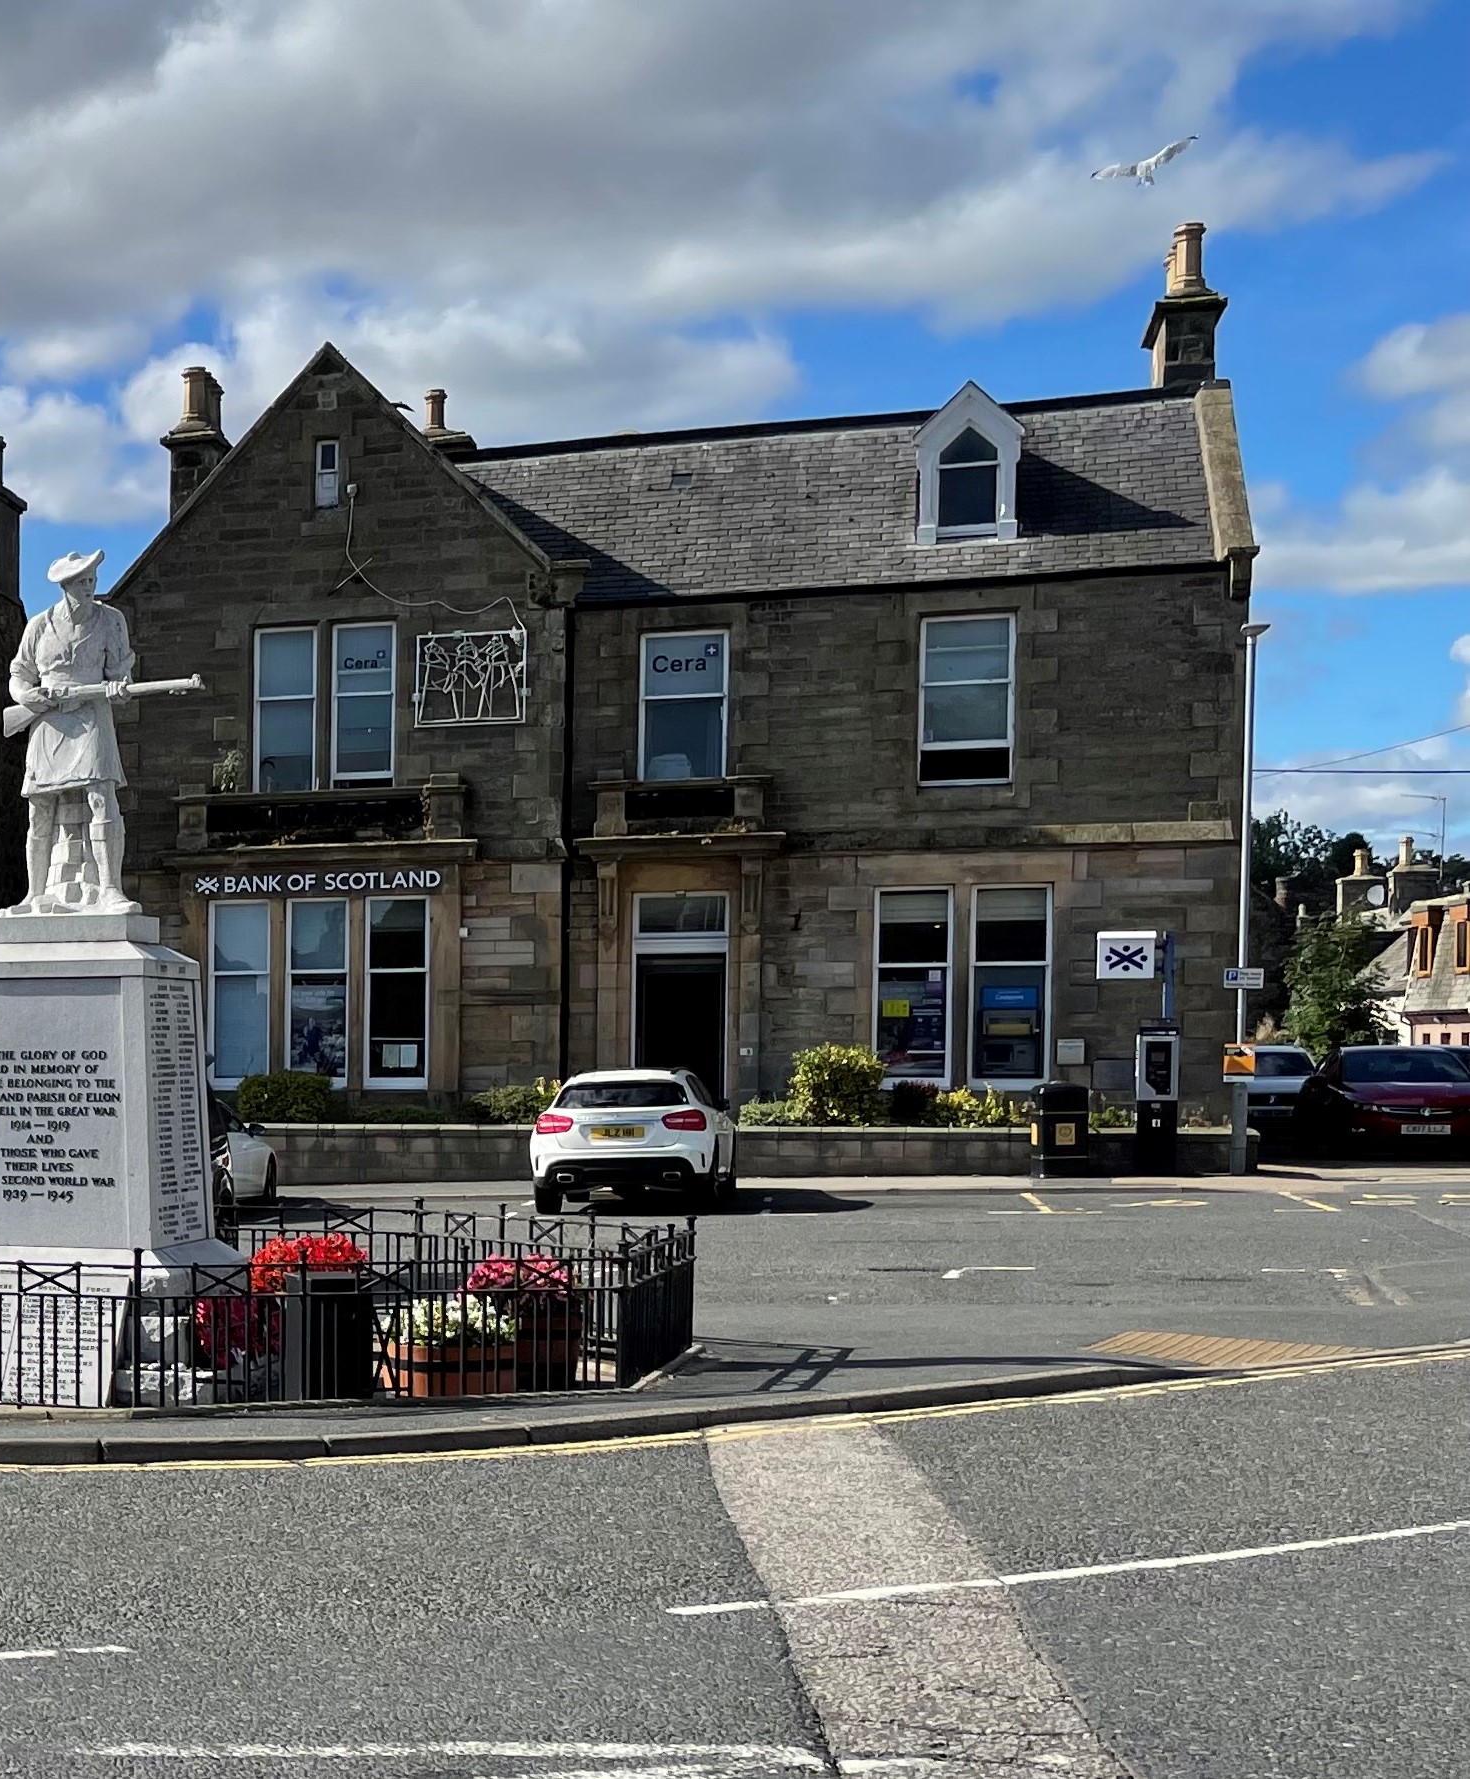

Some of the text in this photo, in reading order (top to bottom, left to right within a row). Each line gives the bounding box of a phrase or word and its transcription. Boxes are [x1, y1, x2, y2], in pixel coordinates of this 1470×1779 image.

[344, 657, 378, 669] Cera
[652, 655, 706, 673] Cera
[223, 870, 441, 893] BANK OF SCOTLAND
[20, 1050, 58, 1060] GLORY
[62, 1050, 76, 1060] OF
[81, 1050, 107, 1060] GOD
[13, 1064, 26, 1074] IN
[31, 1064, 81, 1074] MEMORY
[84, 1064, 99, 1074] OF
[8, 1078, 72, 1088] BELONGING
[76, 1079, 91, 1088] TO
[94, 1079, 115, 1089] THE
[0, 1093, 24, 1102] AND
[27, 1093, 66, 1102] PARISH
[69, 1093, 83, 1102] OF
[86, 1093, 121, 1103] ELLON
[20, 1106, 32, 1116] IN
[34, 1106, 55, 1116] THE
[57, 1106, 90, 1116] GREAT
[93, 1106, 118, 1118] WAR
[11, 1120, 31, 1132] 1914
[48, 1121, 70, 1132] 1919
[26, 1134, 54, 1144] AND
[0, 1148, 37, 1158] THOSE
[41, 1148, 66, 1158] WHO
[69, 1149, 99, 1159] GAVE
[5, 1162, 74, 1172] THEIR LIVES
[2, 1175, 45, 1186] SECOND
[48, 1176, 88, 1187] WORLD
[91, 1177, 115, 1187] WAR
[3, 1189, 28, 1203] 1939
[48, 1190, 74, 1204] 1945
